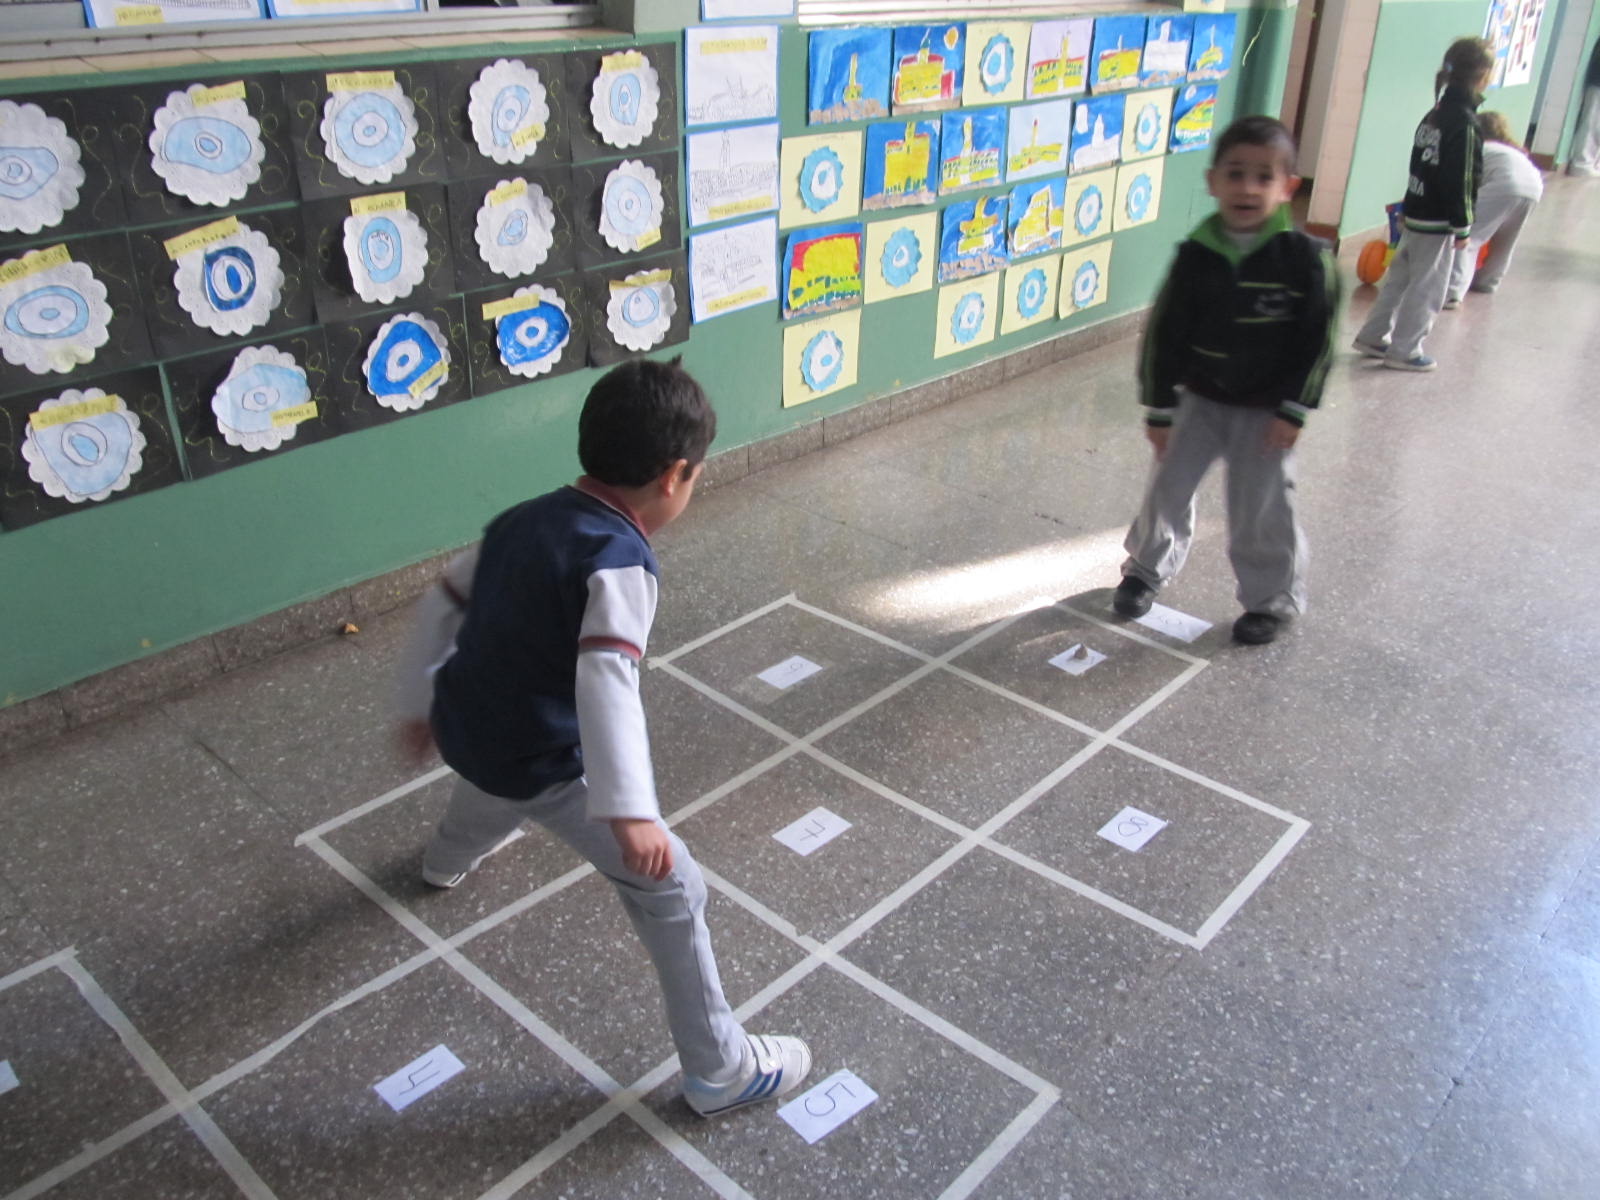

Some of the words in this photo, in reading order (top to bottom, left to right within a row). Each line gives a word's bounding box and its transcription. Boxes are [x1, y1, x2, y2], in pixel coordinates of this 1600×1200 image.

[799, 818, 827, 841] 7
[1117, 816, 1149, 837] 8
[399, 1059, 441, 1096] 4
[804, 1081, 855, 1117] 5
